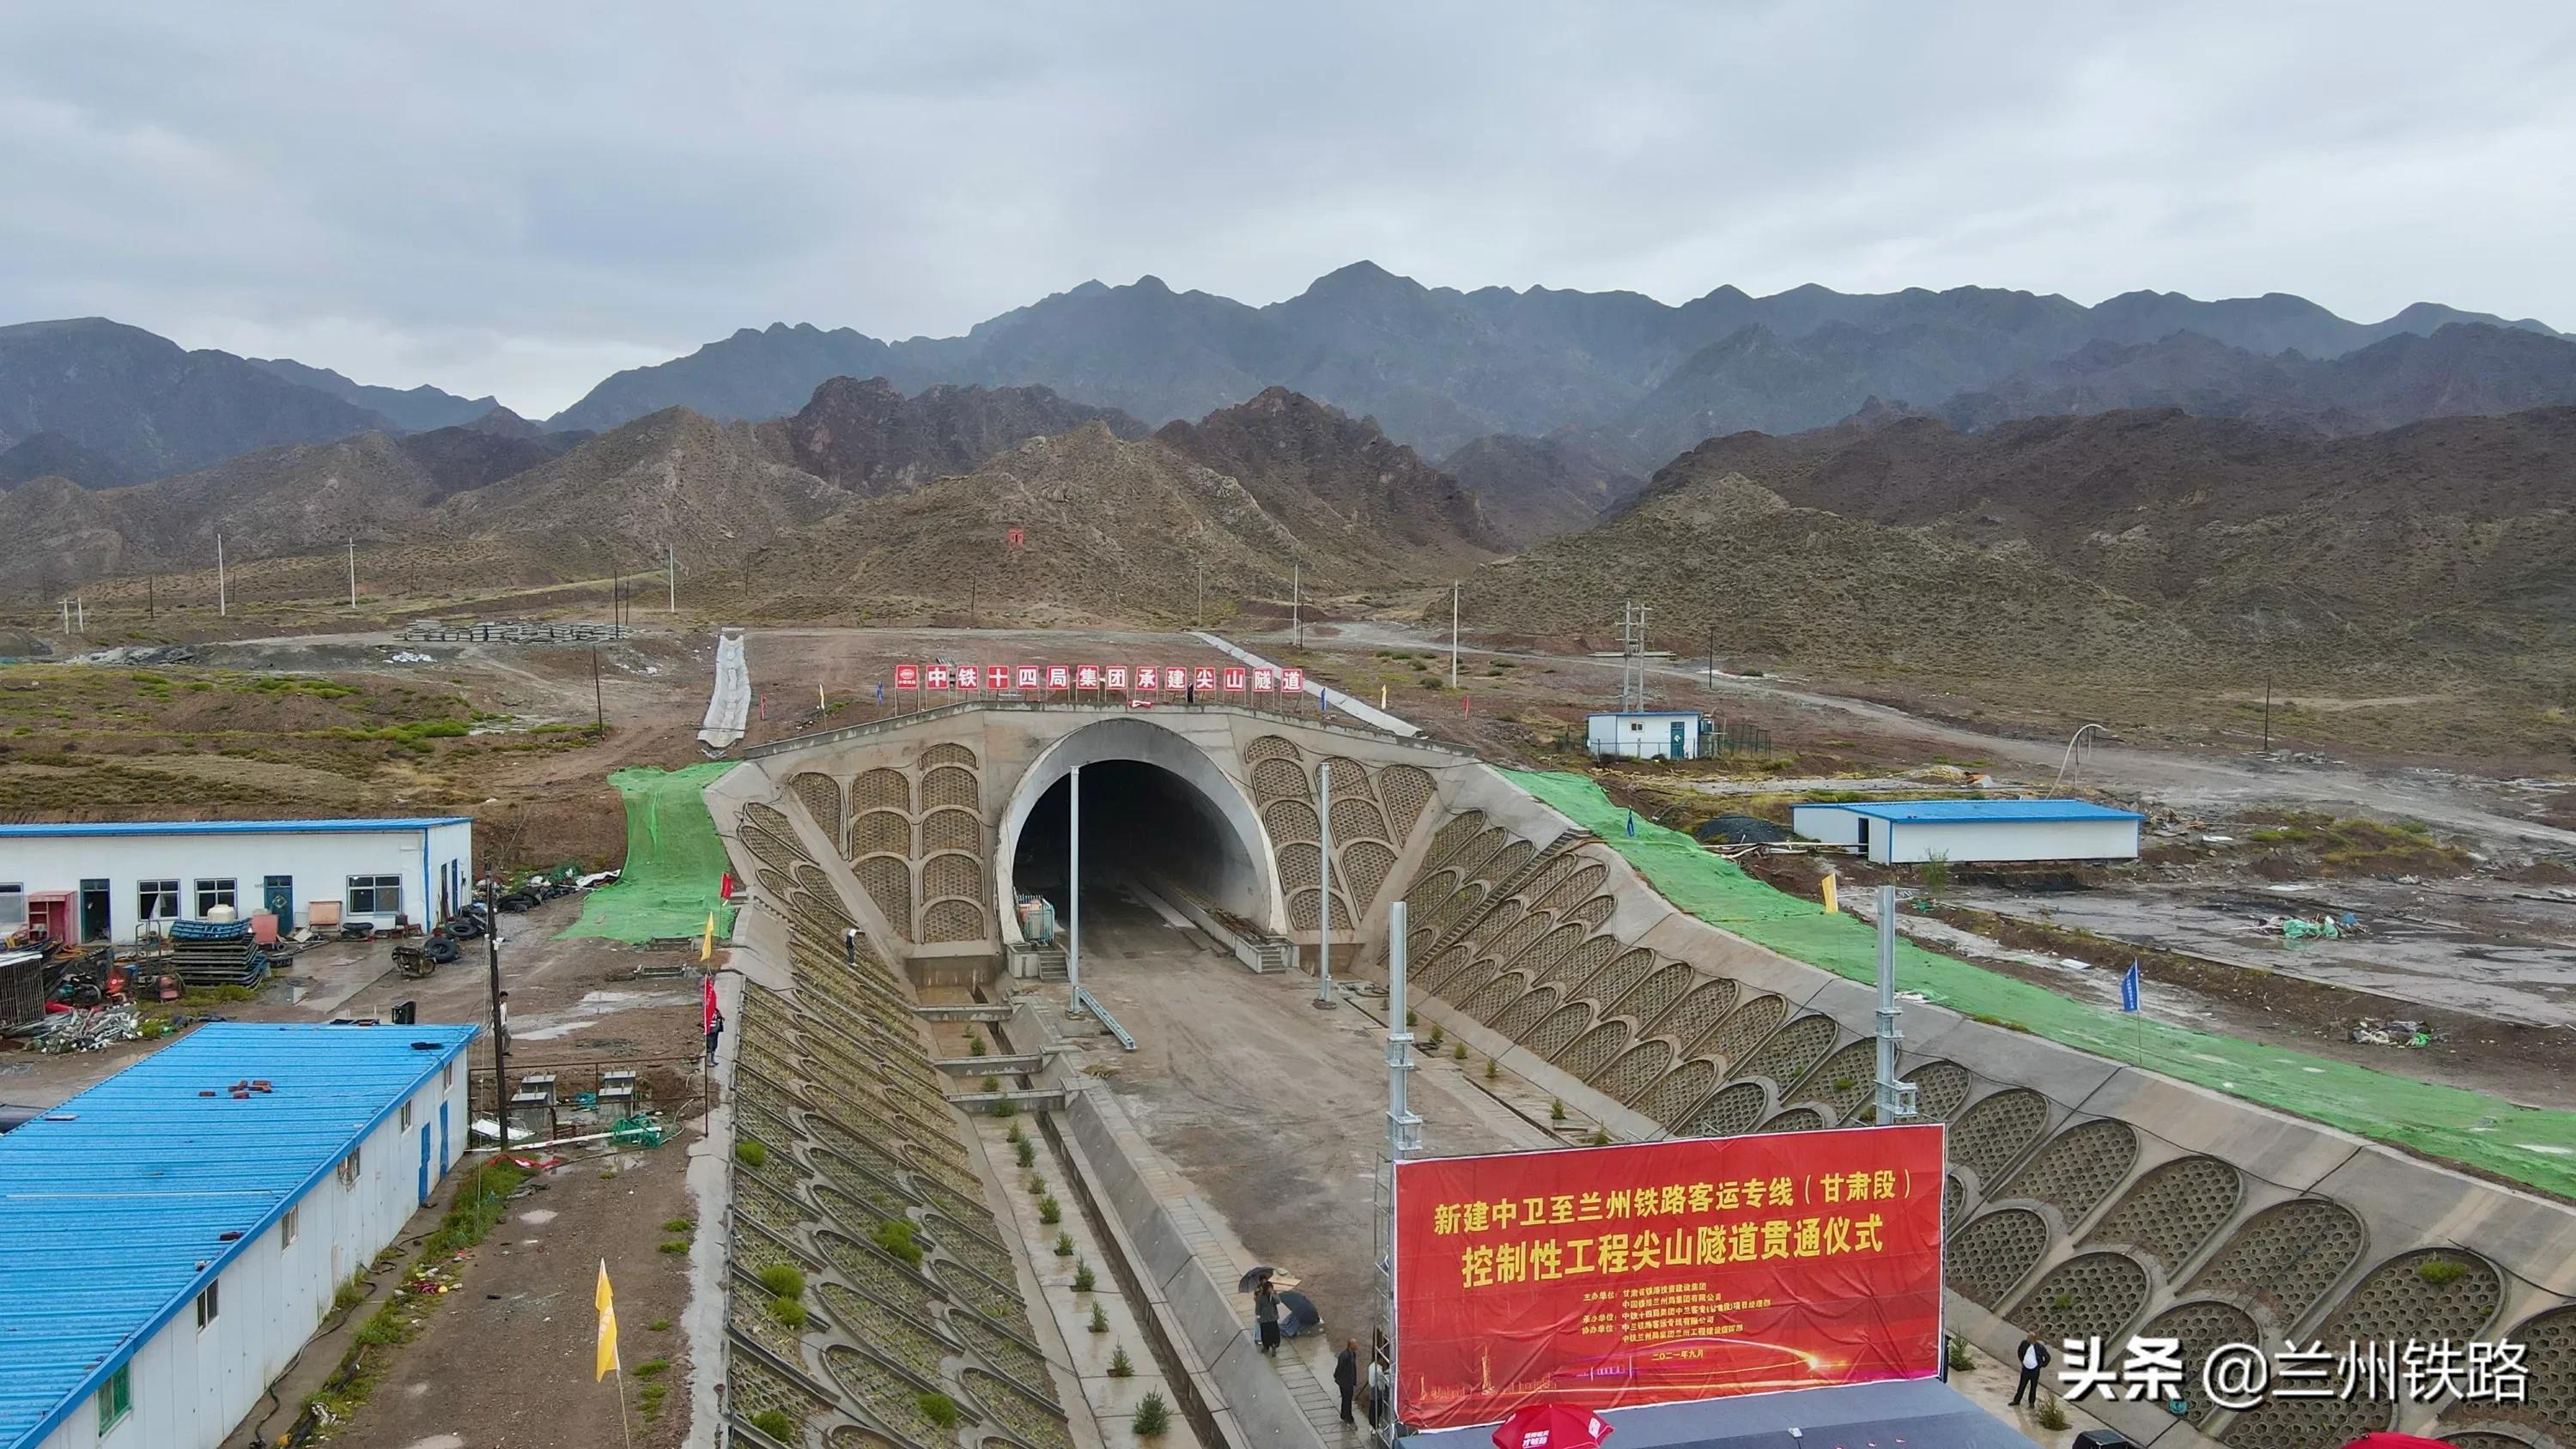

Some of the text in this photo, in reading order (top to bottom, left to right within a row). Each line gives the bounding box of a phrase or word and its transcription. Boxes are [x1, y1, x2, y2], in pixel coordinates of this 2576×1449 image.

[928, 666, 1301, 691] 中铁十四局集团承建尖山隧道
[1433, 1168, 1911, 1235] 新建中卫至兰州铁路客运专线（甘肃段）
[1461, 1213, 1883, 1288] 控制性工程尖山隧道贯通仪式
